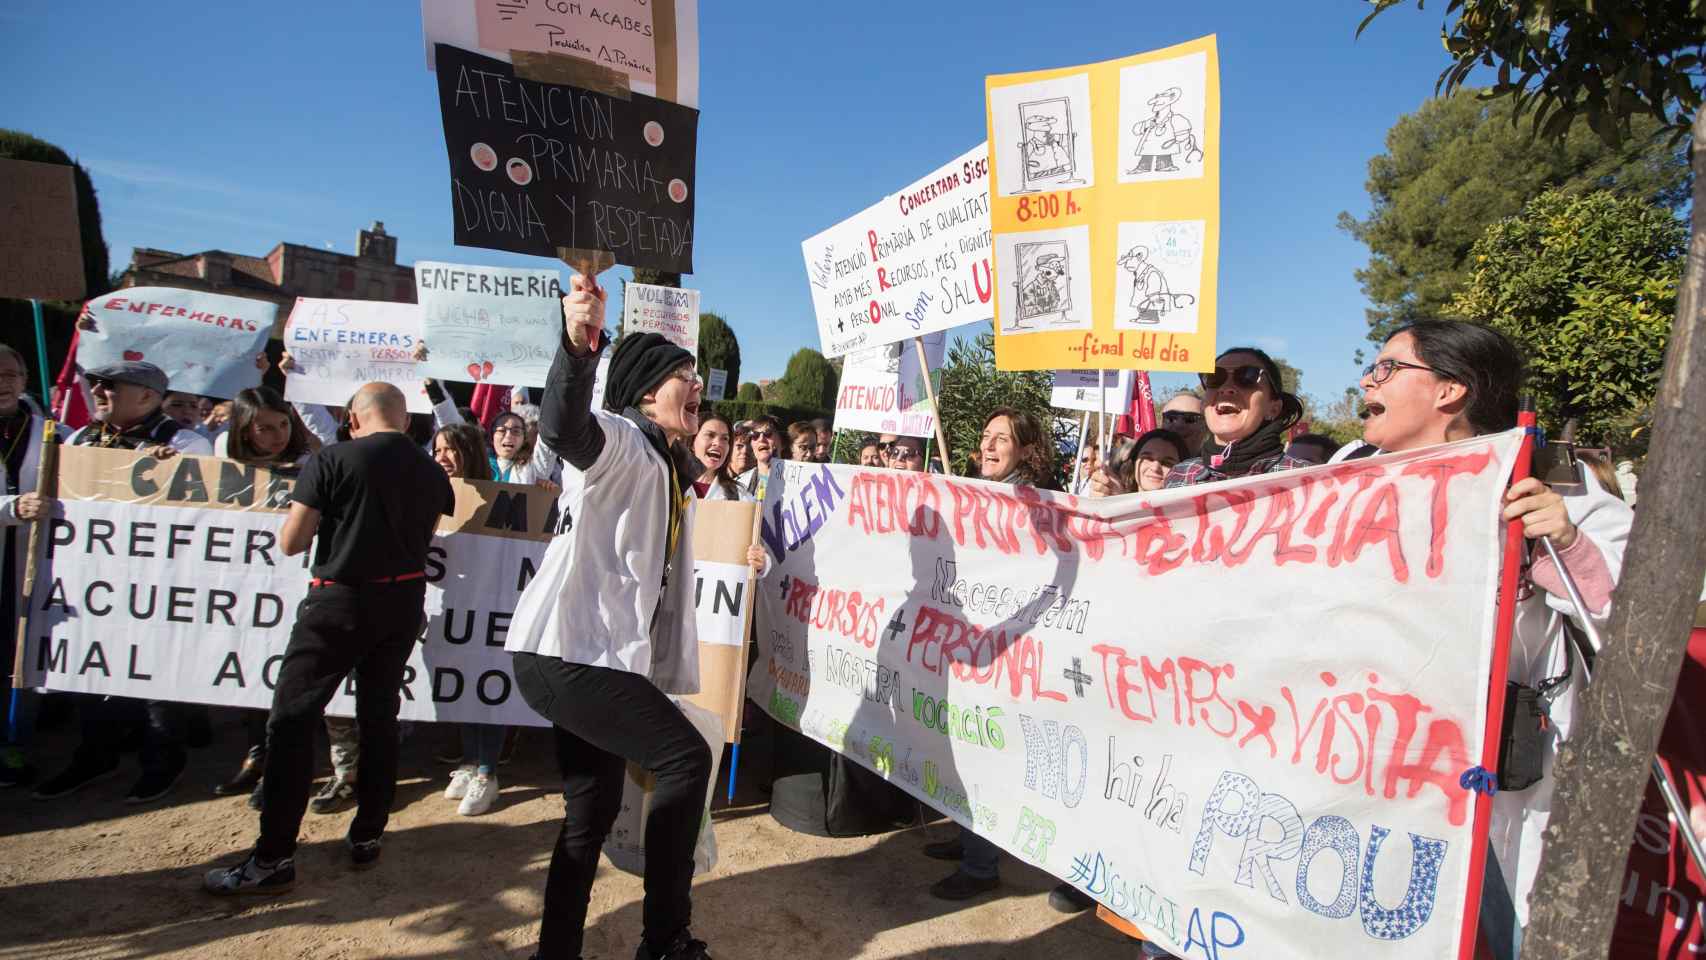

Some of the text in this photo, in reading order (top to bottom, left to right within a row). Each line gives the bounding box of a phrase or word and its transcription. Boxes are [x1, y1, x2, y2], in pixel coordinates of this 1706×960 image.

[590, 7, 653, 37] ACABES
[516, 133, 662, 204] PRIMARIA
[454, 178, 693, 257] DIGNA Y RESPETADA
[900, 172, 960, 216] CONCERTADA
[1016, 191, 1082, 222] 8:00 h.
[834, 191, 989, 281] ATENCIÓ PRIMÀRIA DE QUALITAT
[637, 287, 689, 308] VOLEM
[833, 292, 853, 312] AMB
[854, 275, 873, 304] MÉS
[935, 242, 957, 274] MÉS
[103, 298, 258, 332] ENFERMERAS
[294, 327, 414, 348] ENFERMERAS
[849, 299, 901, 330] PERSONAL
[1132, 335, 1155, 360] del
[1160, 334, 1190, 362] dia
[837, 381, 897, 413] ATENCIÓ
[761, 464, 845, 565] VOLEM
[848, 473, 941, 539] ATENCIÓ
[930, 557, 1091, 634] Necessitem
[37, 638, 152, 682] MAL
[785, 575, 885, 649] RECURSOS
[907, 607, 1068, 702] PERSONAL
[1091, 643, 1238, 739] TEMPS
[825, 644, 904, 712] NOSTRA
[912, 688, 1006, 751] VOCACIÓ
[1018, 713, 1088, 809] NO
[1104, 735, 1143, 808] hi
[1144, 754, 1185, 835] ha
[1189, 769, 1448, 941] PROU
[1011, 806, 1057, 863] PER
[1184, 906, 1246, 960] AP
